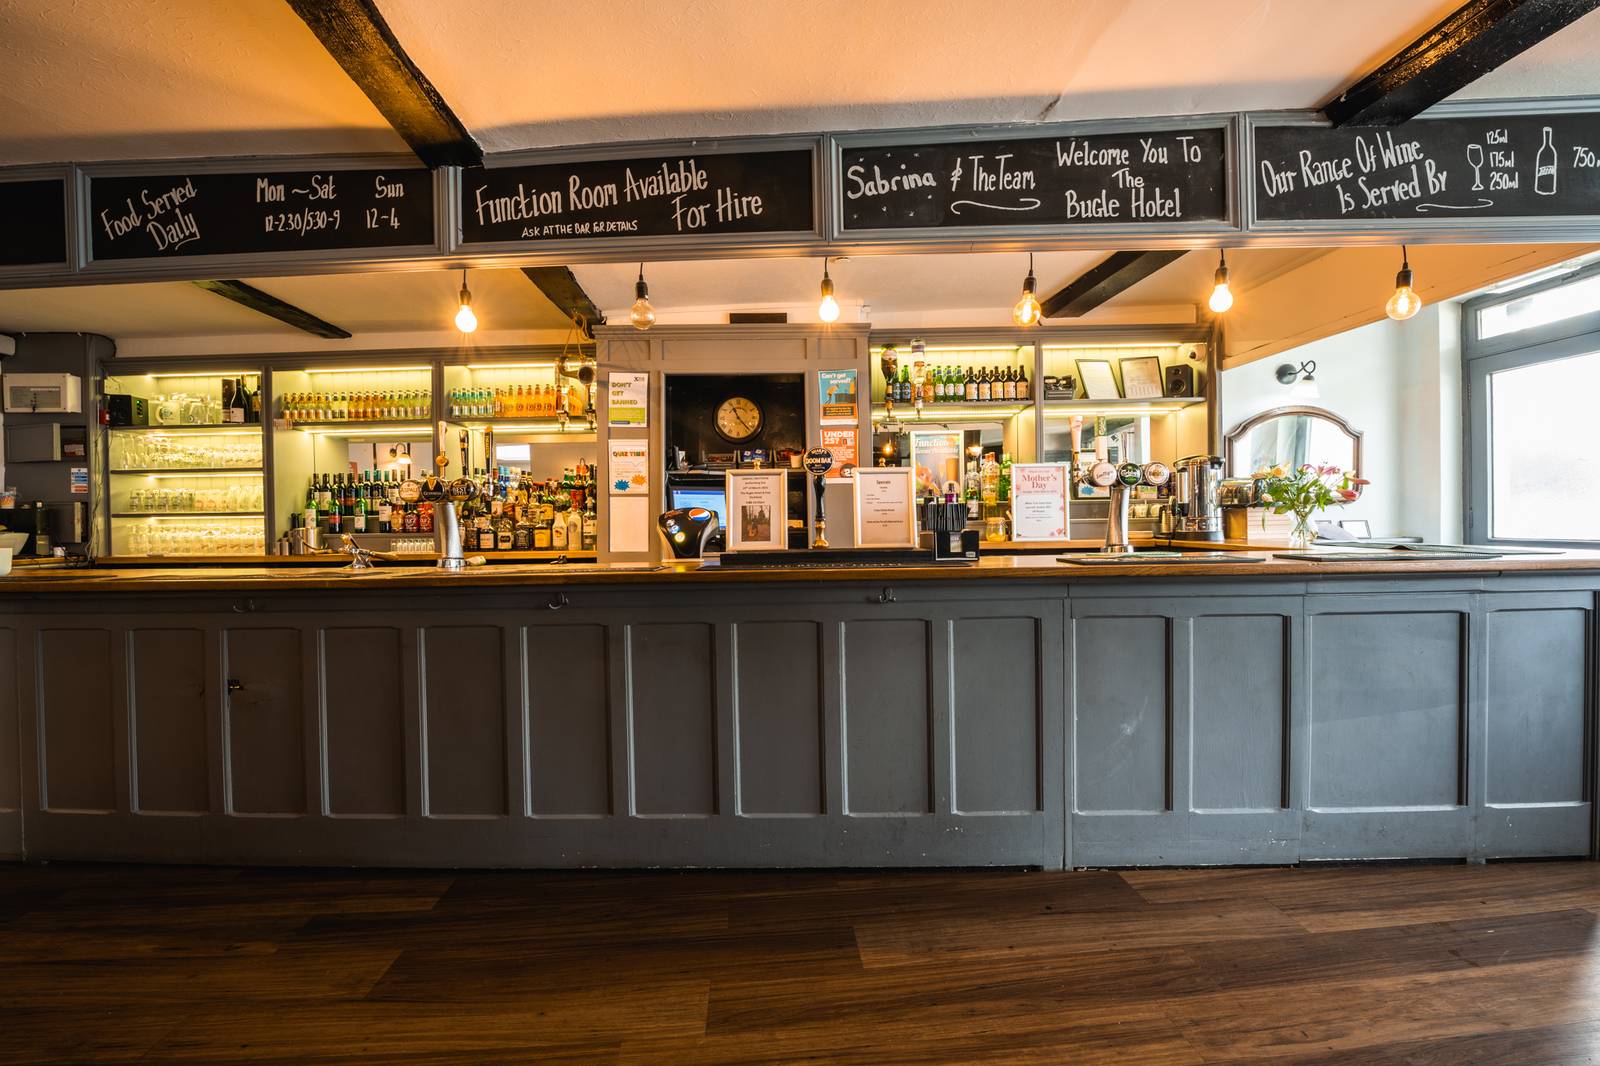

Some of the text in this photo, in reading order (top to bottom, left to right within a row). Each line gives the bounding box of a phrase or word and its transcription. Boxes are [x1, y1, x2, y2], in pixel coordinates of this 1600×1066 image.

[1056, 136, 1202, 166] Welcome You To
[1486, 129, 1508, 144] 125ml
[1261, 131, 1424, 197] Our Range Of Wine
[1490, 151, 1515, 168] 175ml
[256, 178, 285, 202] Mon
[309, 175, 337, 200] Sat
[375, 175, 404, 199] Sun
[847, 164, 937, 199] Sabrina
[968, 155, 997, 191] The
[995, 154, 1036, 191] Team
[1112, 168, 1145, 190] The
[1336, 184, 1355, 214] Is
[1358, 164, 1422, 209] Served
[1490, 172, 1519, 191] 250ml
[475, 159, 709, 226] Function Room Available
[1065, 188, 1182, 219] Bugle Hotel
[101, 177, 197, 240] Food Served
[671, 187, 763, 231] For Hire
[147, 207, 200, 251] Daily
[574, 222, 591, 234] BAR
[606, 220, 638, 232] DETAILS
[1022, 474, 1057, 482] Mother's
